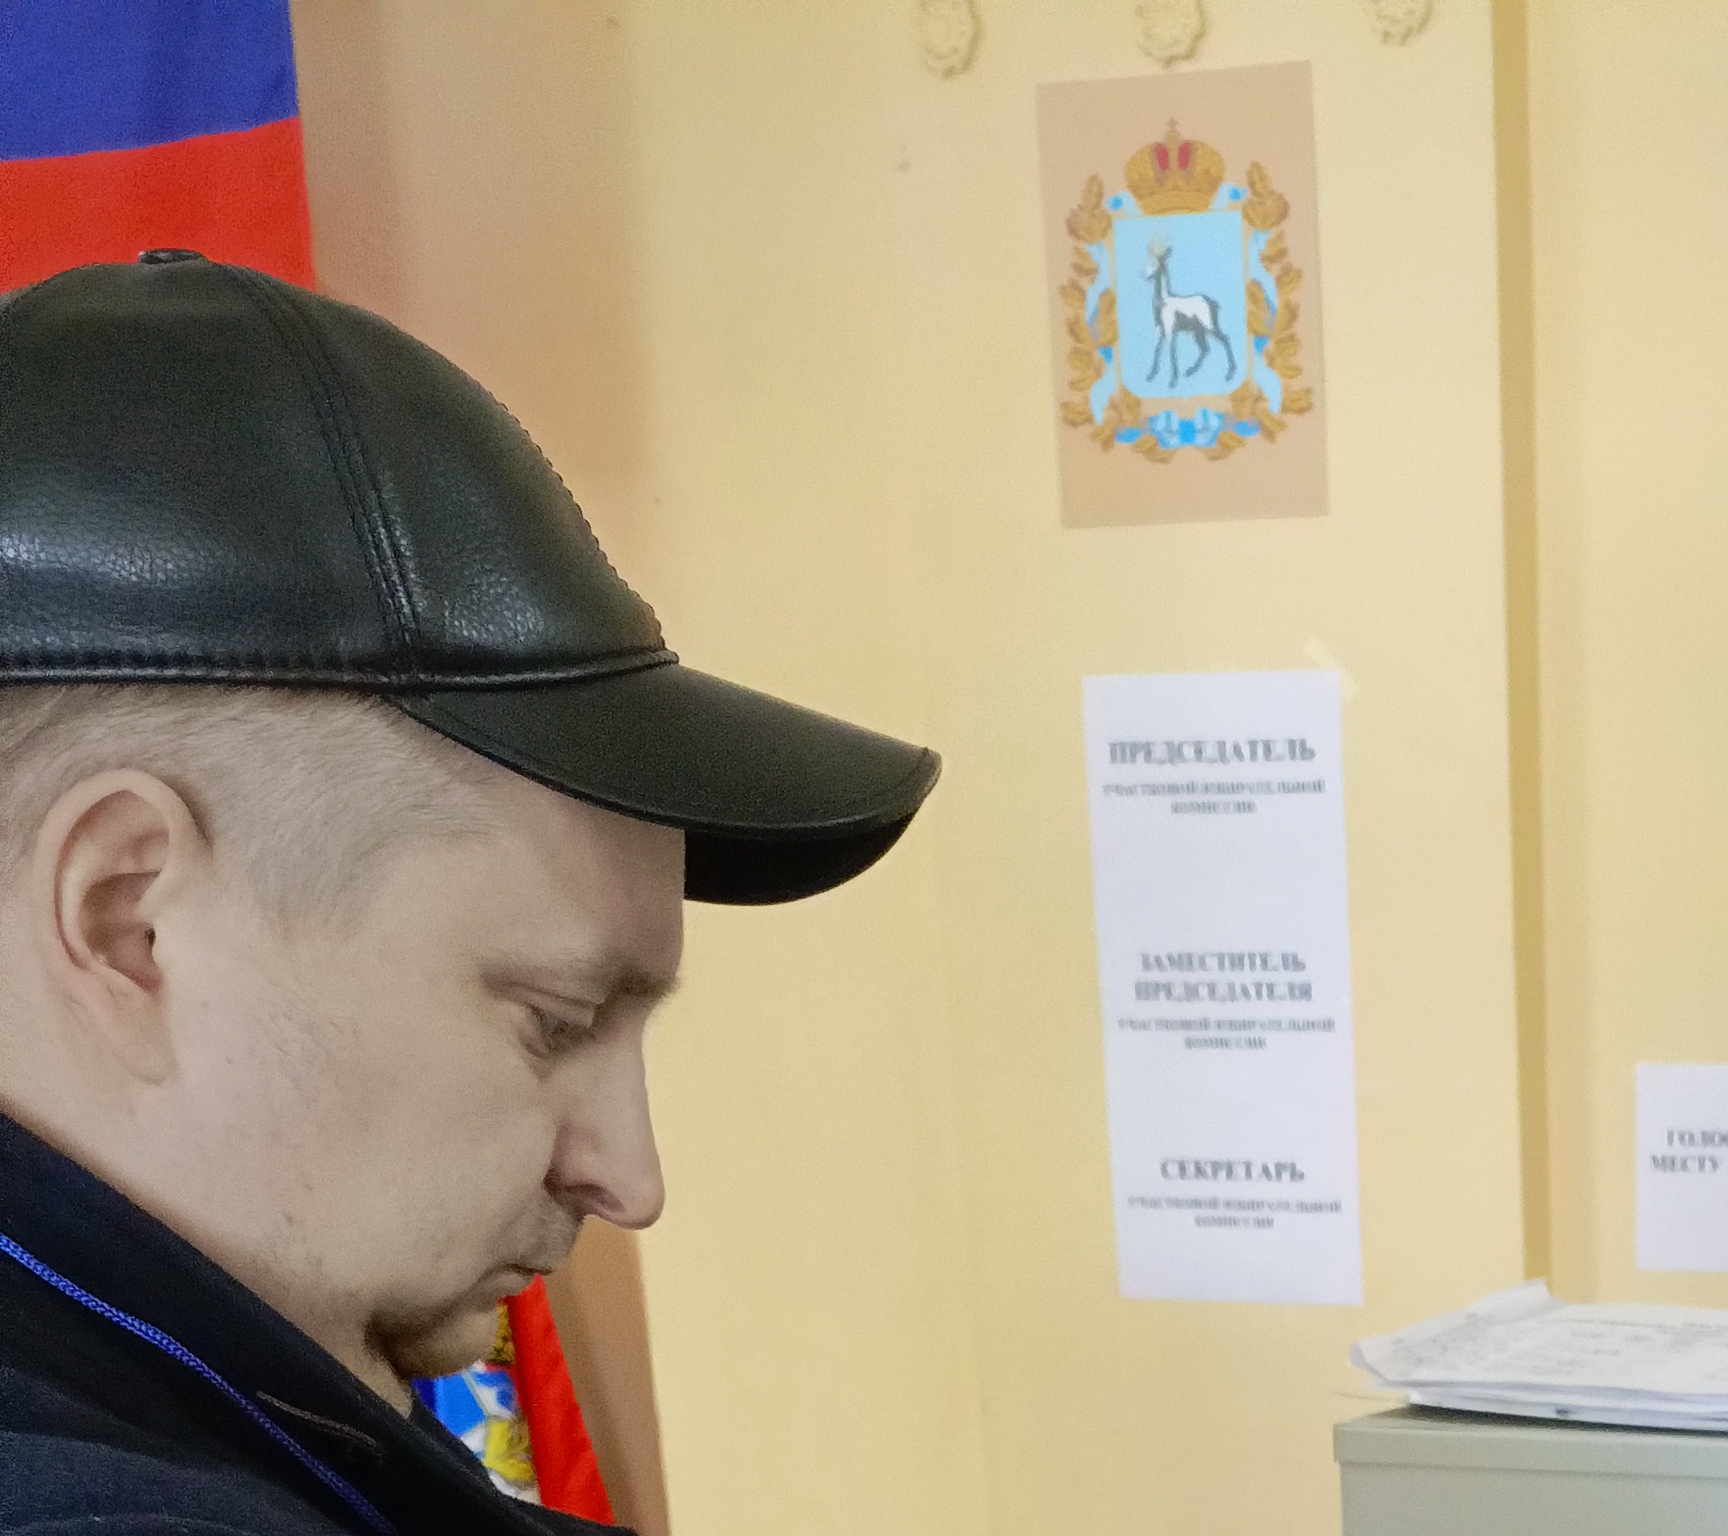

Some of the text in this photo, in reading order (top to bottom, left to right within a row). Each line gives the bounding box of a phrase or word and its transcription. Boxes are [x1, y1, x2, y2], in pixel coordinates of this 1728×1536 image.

[1108, 738, 1317, 766] ПРЕДСЕДАТЕЛЬ
[1140, 951, 1307, 974] ЗАМЕСТИТЕЛЬ
[1134, 980, 1314, 1003] ПРЕДСЕДАТЕЛЯ
[1158, 1156, 1306, 1182] СЕКРЕТАРЬ
[1651, 1154, 1720, 1174] МЕСТУ
